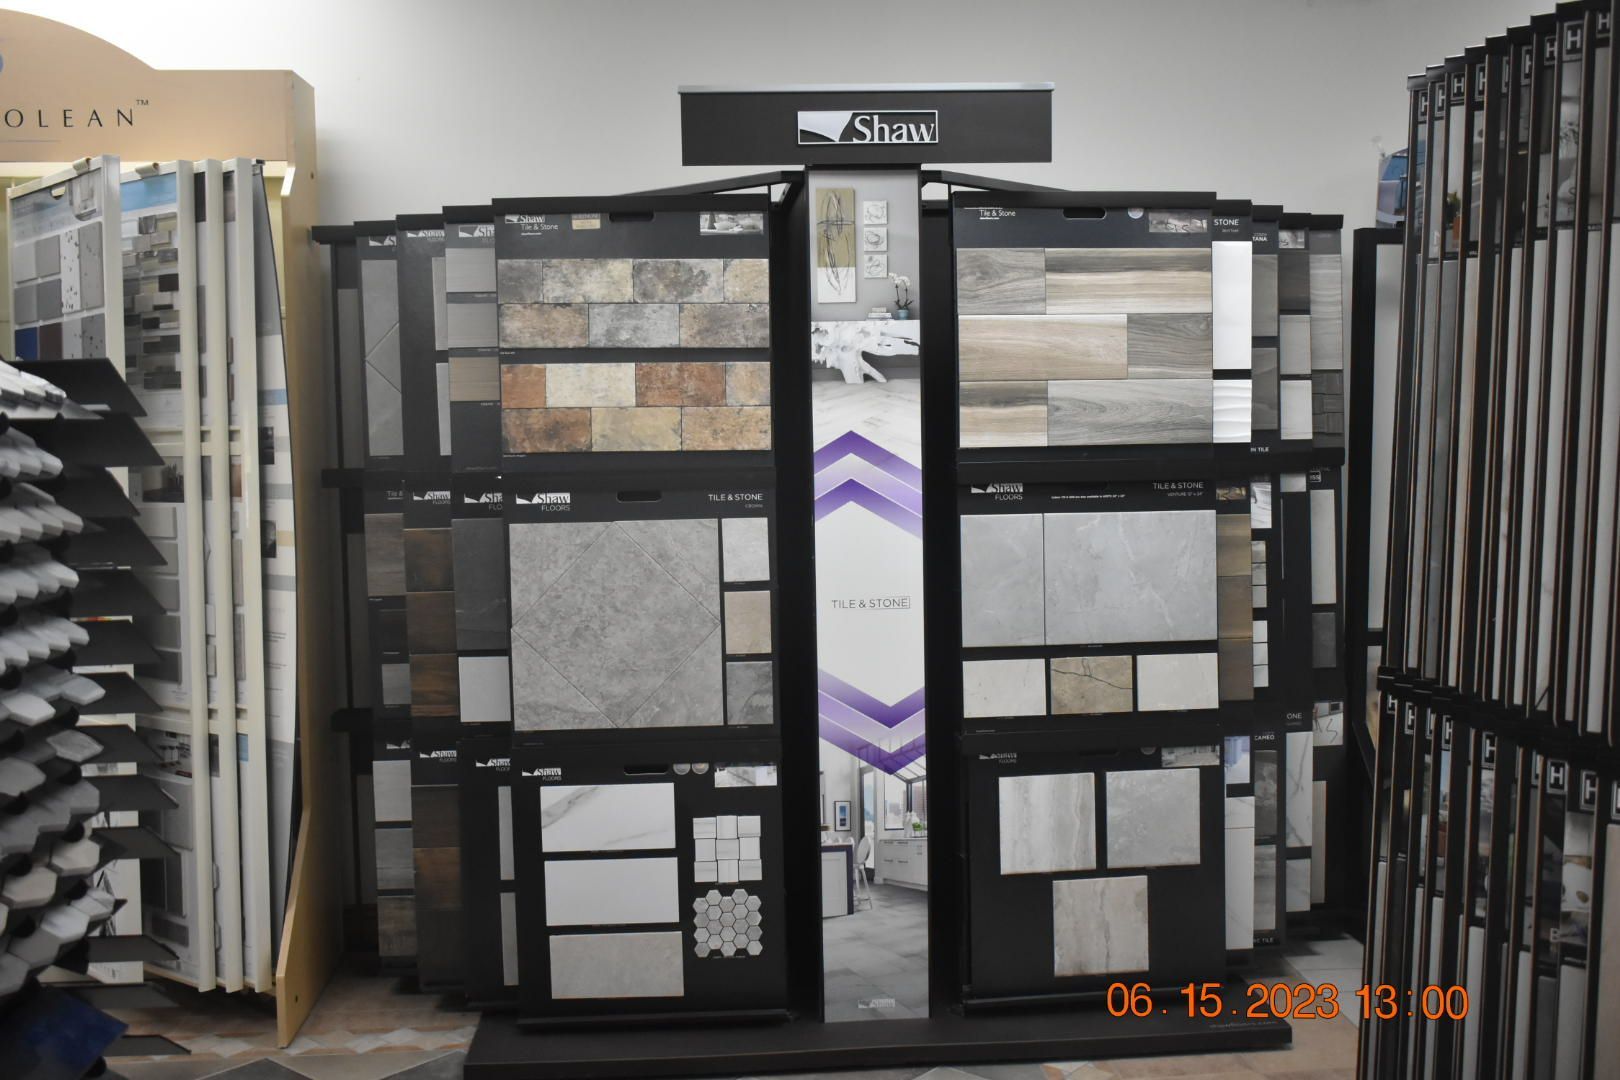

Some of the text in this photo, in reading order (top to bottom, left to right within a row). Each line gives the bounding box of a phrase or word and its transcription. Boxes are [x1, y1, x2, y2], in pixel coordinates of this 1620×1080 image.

[1567, 28, 1581, 50] H
[1453, 77, 1465, 94] H
[4, 108, 133, 127] OLEAN
[851, 113, 936, 143] Shaw
[979, 209, 1016, 217] Tile & Stone
[520, 214, 545, 224] Shaw
[1213, 218, 1239, 227] STONE
[520, 222, 559, 231] Tile & Stone
[1152, 481, 1204, 490] TILE & STONE
[536, 492, 571, 504] Shaw
[708, 493, 764, 501] TILE & STONE
[994, 493, 1023, 501] FLOORS
[541, 504, 571, 512] FLOORS
[831, 597, 909, 609] TILE & STONE
[537, 768, 562, 776] Shaw
[1550, 766, 1564, 785] H
